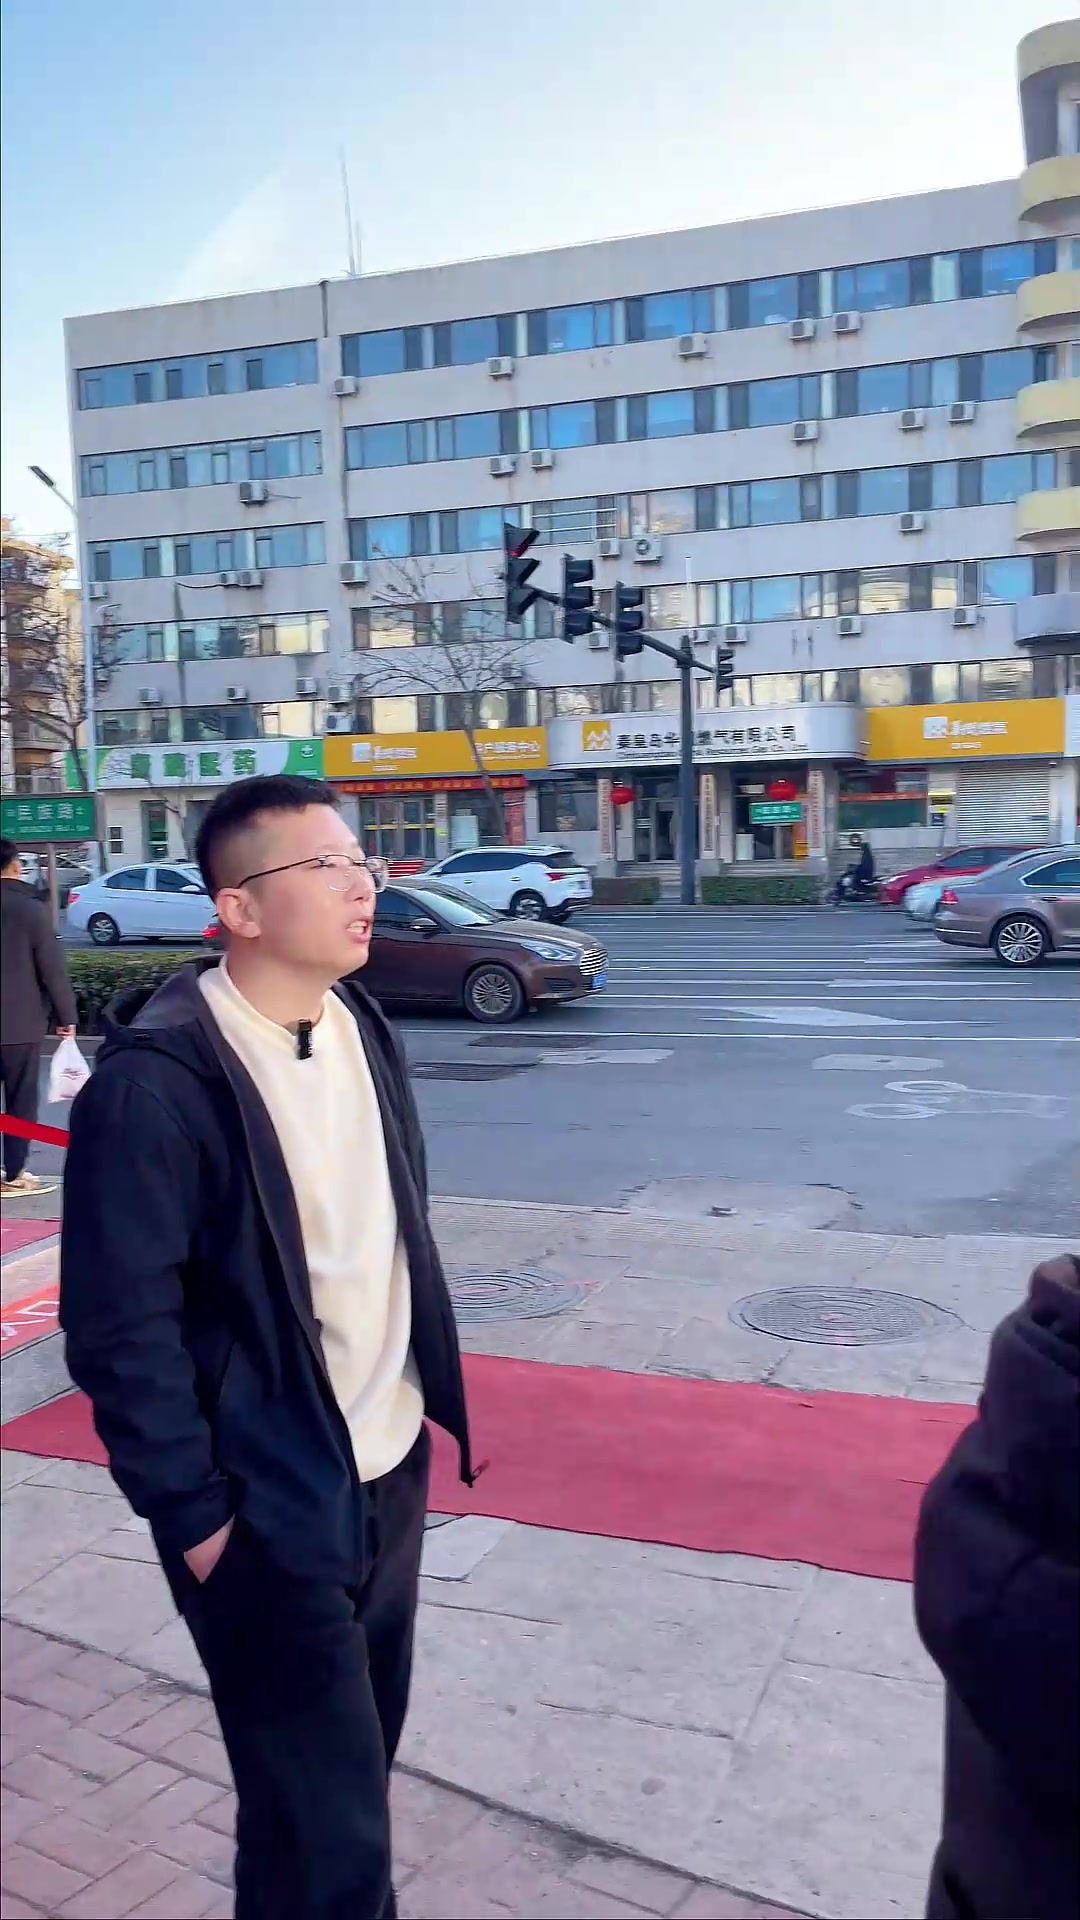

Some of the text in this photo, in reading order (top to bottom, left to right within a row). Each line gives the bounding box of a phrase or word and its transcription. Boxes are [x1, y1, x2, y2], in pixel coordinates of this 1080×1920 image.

[615, 725, 797, 750] 秦皇岛华燃气有限公司
